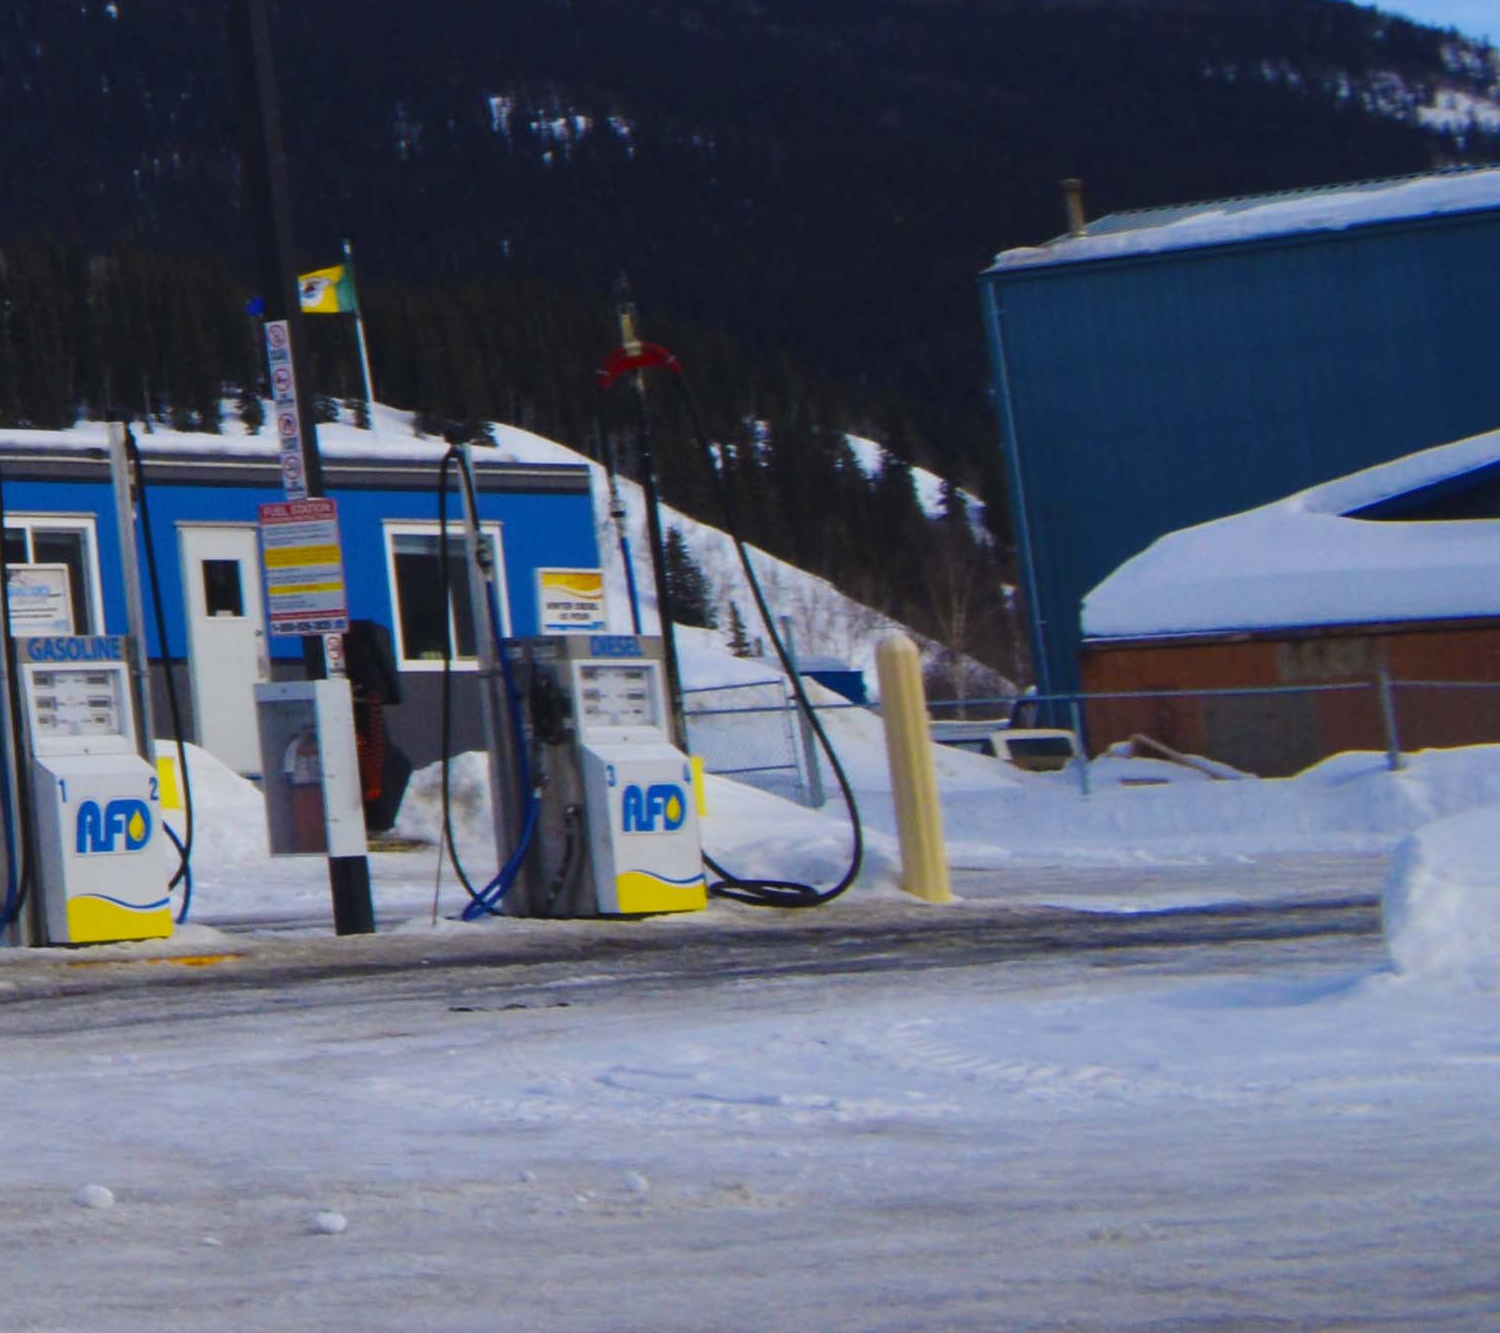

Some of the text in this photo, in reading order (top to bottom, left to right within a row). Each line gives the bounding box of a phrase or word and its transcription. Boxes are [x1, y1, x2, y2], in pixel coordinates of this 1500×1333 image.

[27, 637, 122, 661] GASOLINE
[606, 764, 617, 787] 3
[58, 779, 67, 803] 1
[149, 777, 159, 801] 2
[622, 784, 686, 832] AFD
[76, 799, 152, 853] AFD
